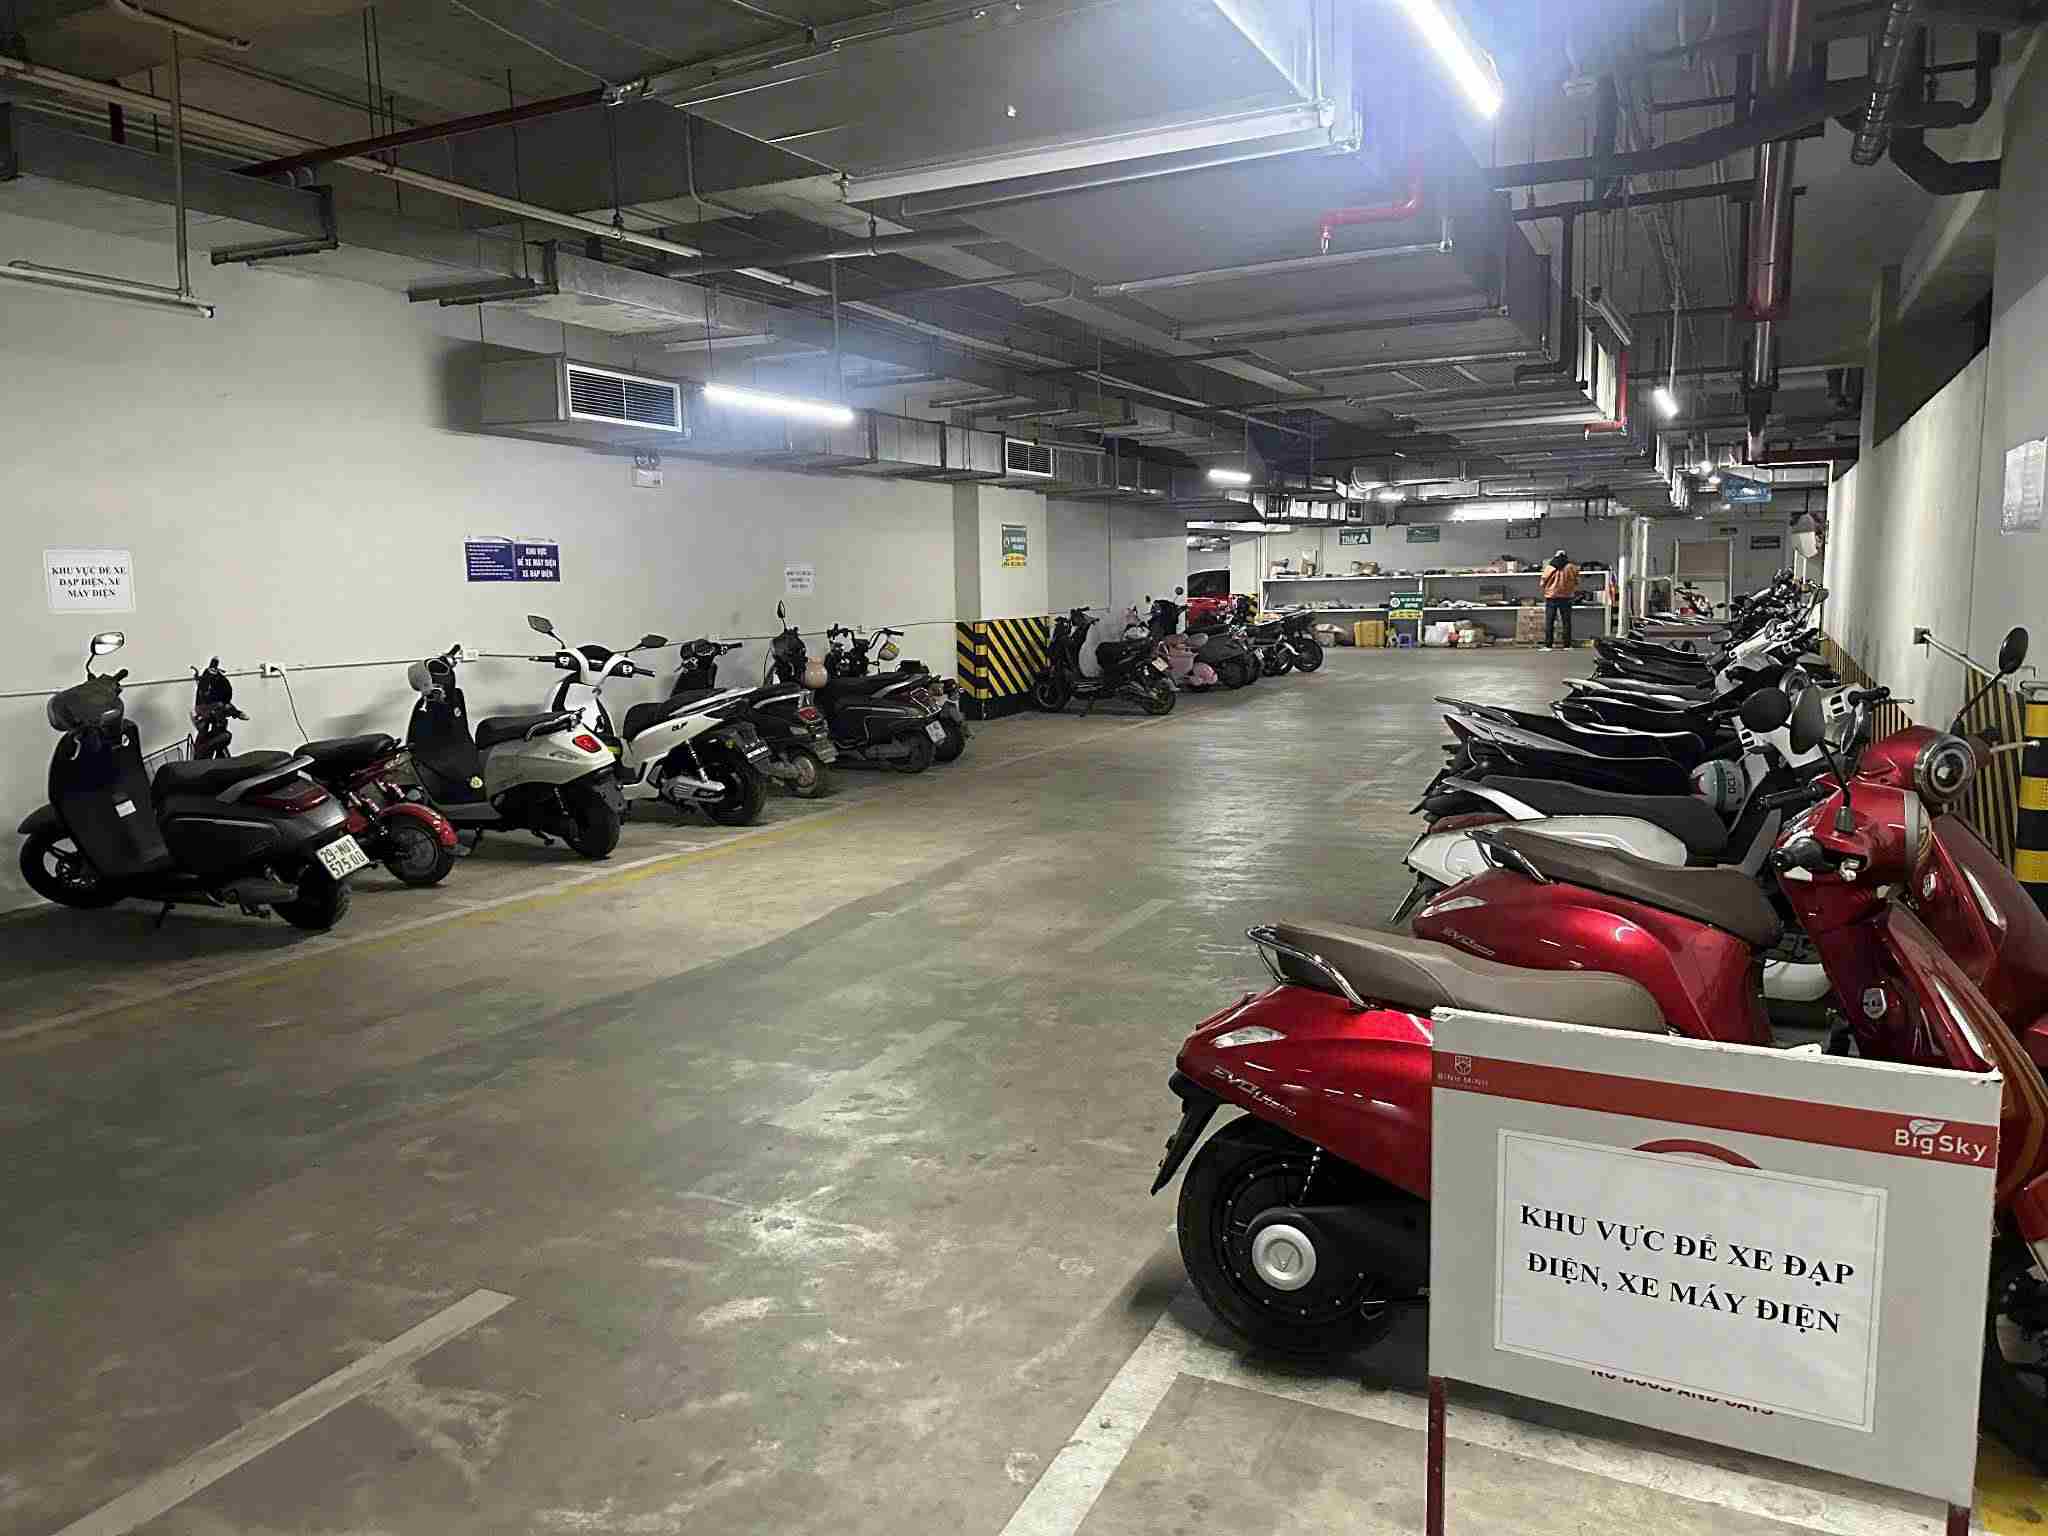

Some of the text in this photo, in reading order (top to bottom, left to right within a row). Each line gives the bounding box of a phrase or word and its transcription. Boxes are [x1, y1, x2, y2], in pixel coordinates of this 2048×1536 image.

[1520, 1204, 1587, 1236] KHU
[1597, 1219, 1665, 1251] VỰC
[1727, 1243, 1774, 1272] XE
[1783, 1254, 1854, 1287] ĐẠP
[1528, 1251, 1840, 1334] ĐIỆN, XE MÁY ĐIỆN
